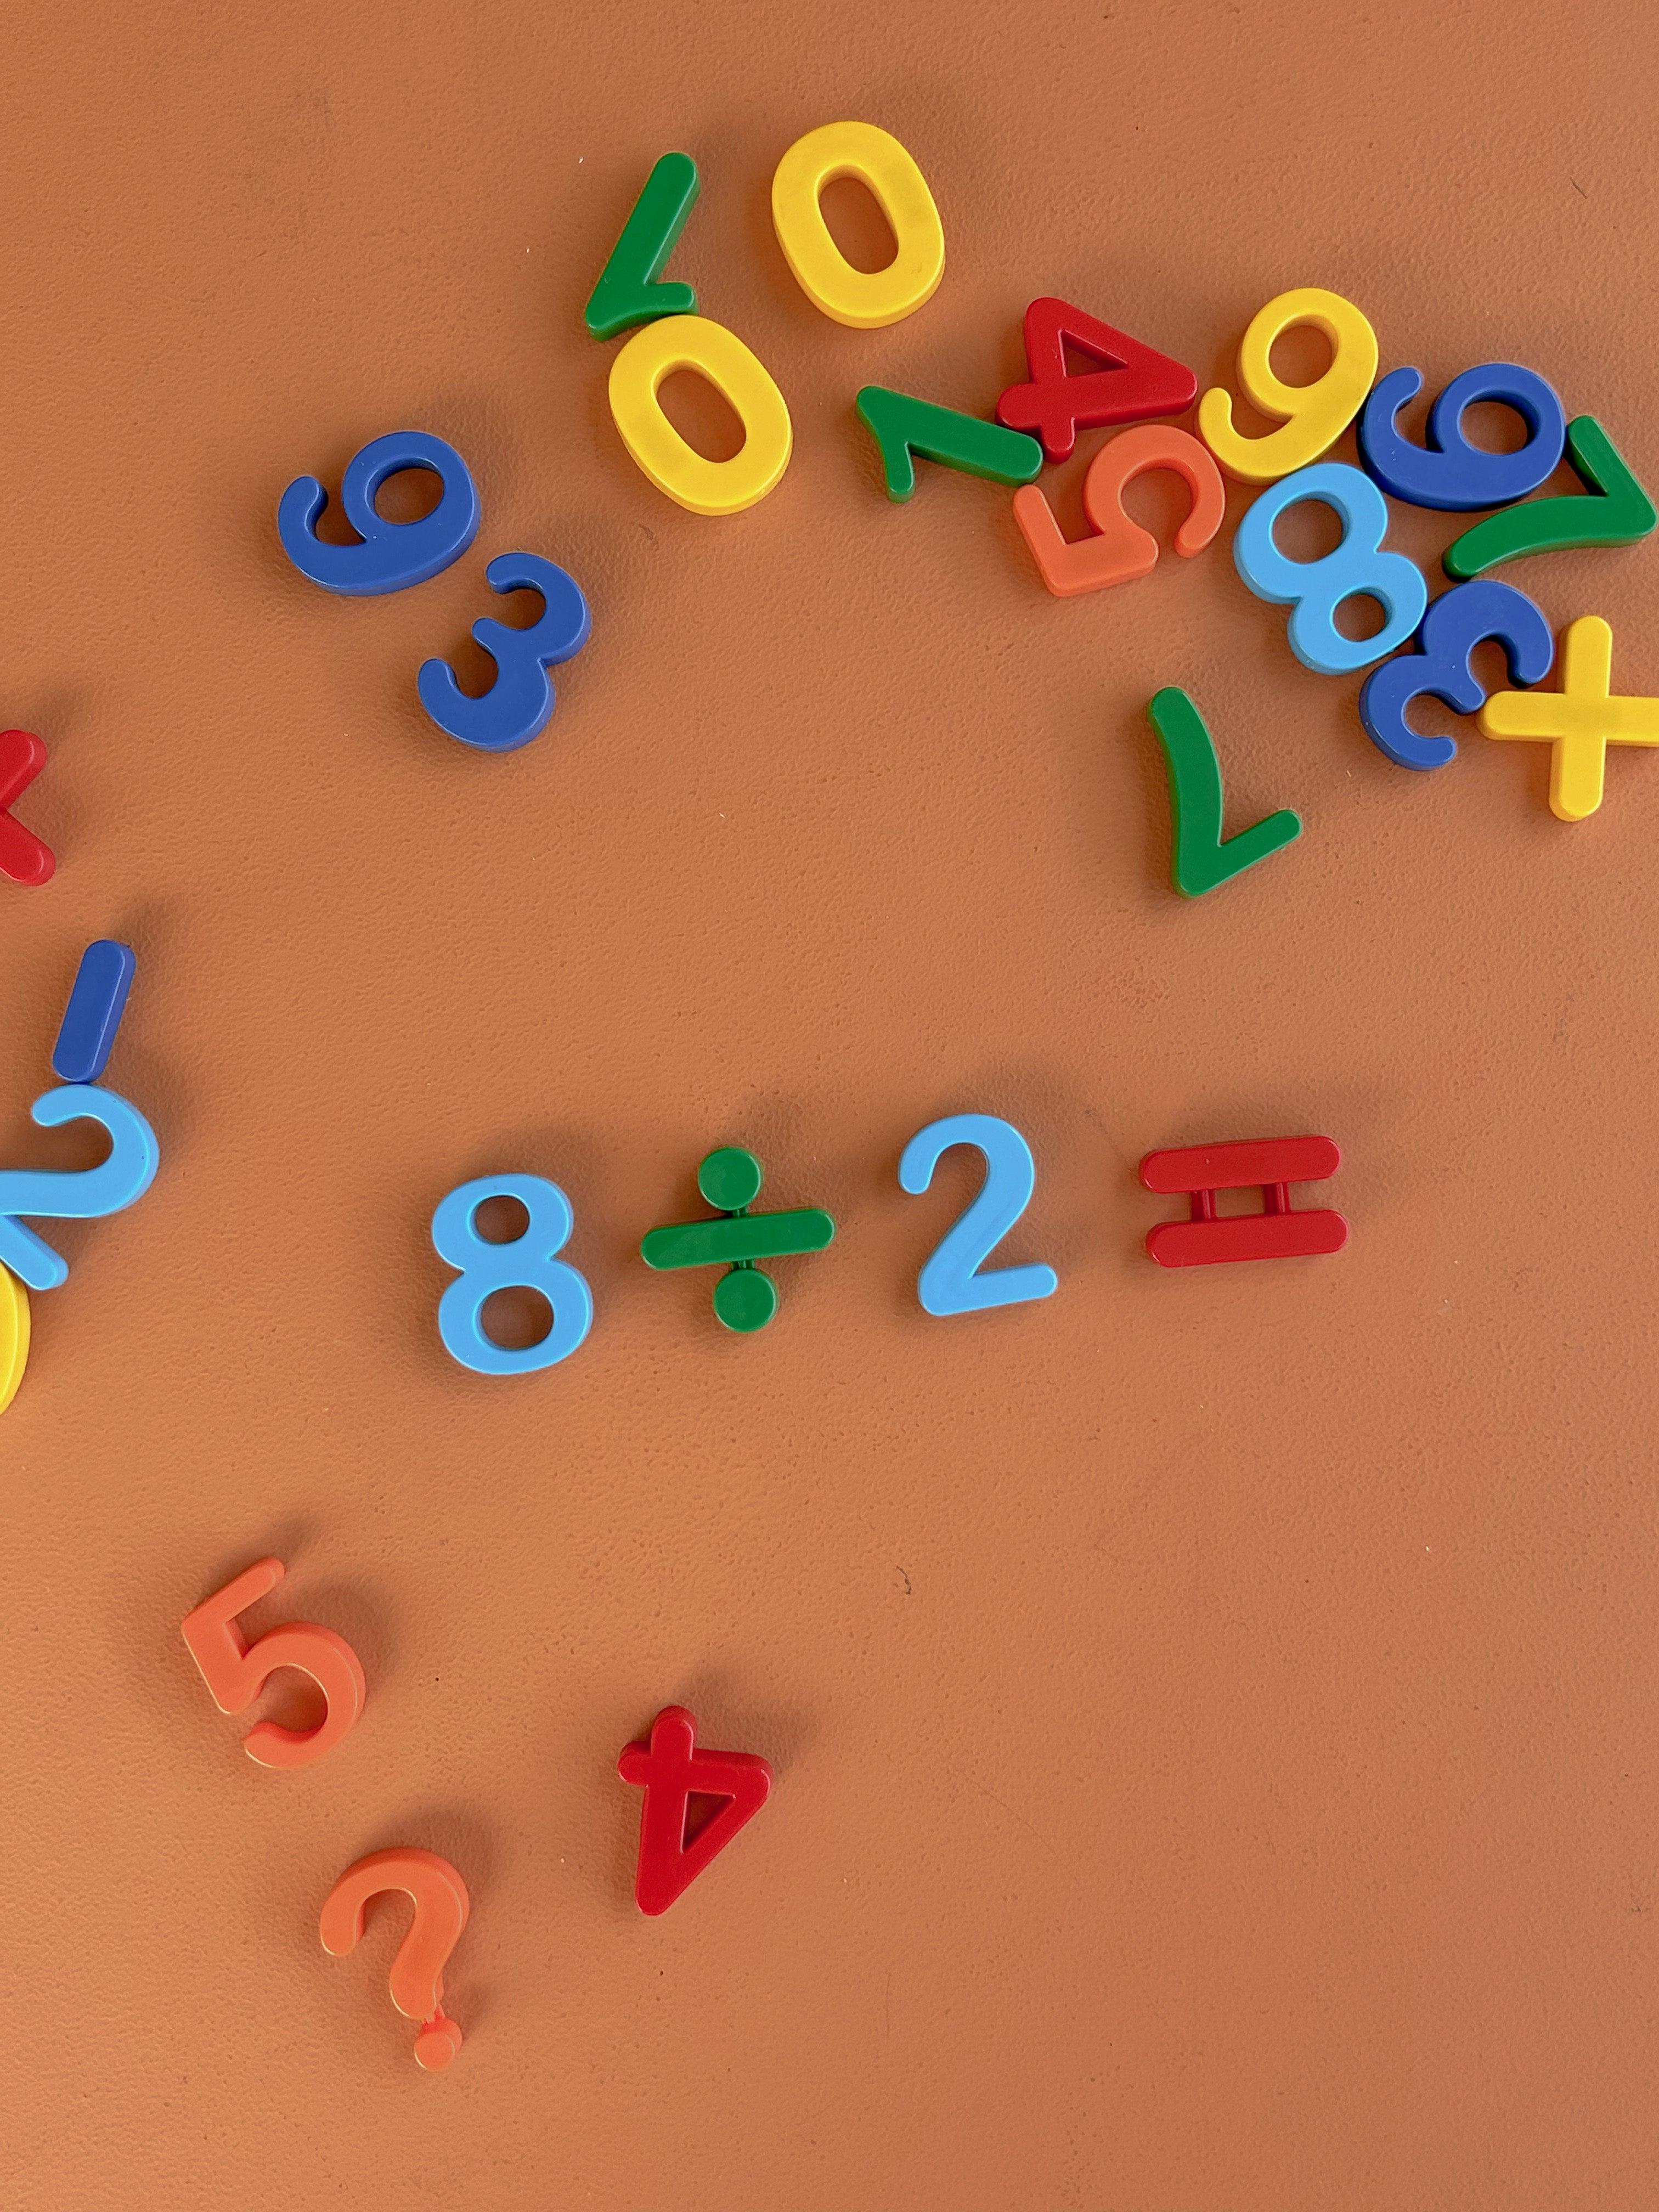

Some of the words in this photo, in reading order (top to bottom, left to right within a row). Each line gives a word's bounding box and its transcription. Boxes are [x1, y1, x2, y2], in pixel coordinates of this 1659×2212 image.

[856, 385, 1045, 503] 1
[995, 297, 1198, 464] 4
[1013, 424, 1227, 597] 5
[1233, 462, 1427, 675] 8
[1443, 415, 1657, 580] 7
[417, 551, 591, 751] 3
[1358, 579, 1554, 771] 3
[1147, 686, 1304, 899] 7
[431, 1172, 594, 1376] 8
[898, 1113, 1059, 1318] 2
[1139, 1135, 1350, 1269] =
[180, 1557, 366, 1770] 5
[617, 1705, 772, 1918] 4
[319, 1847, 470, 2072] ?
